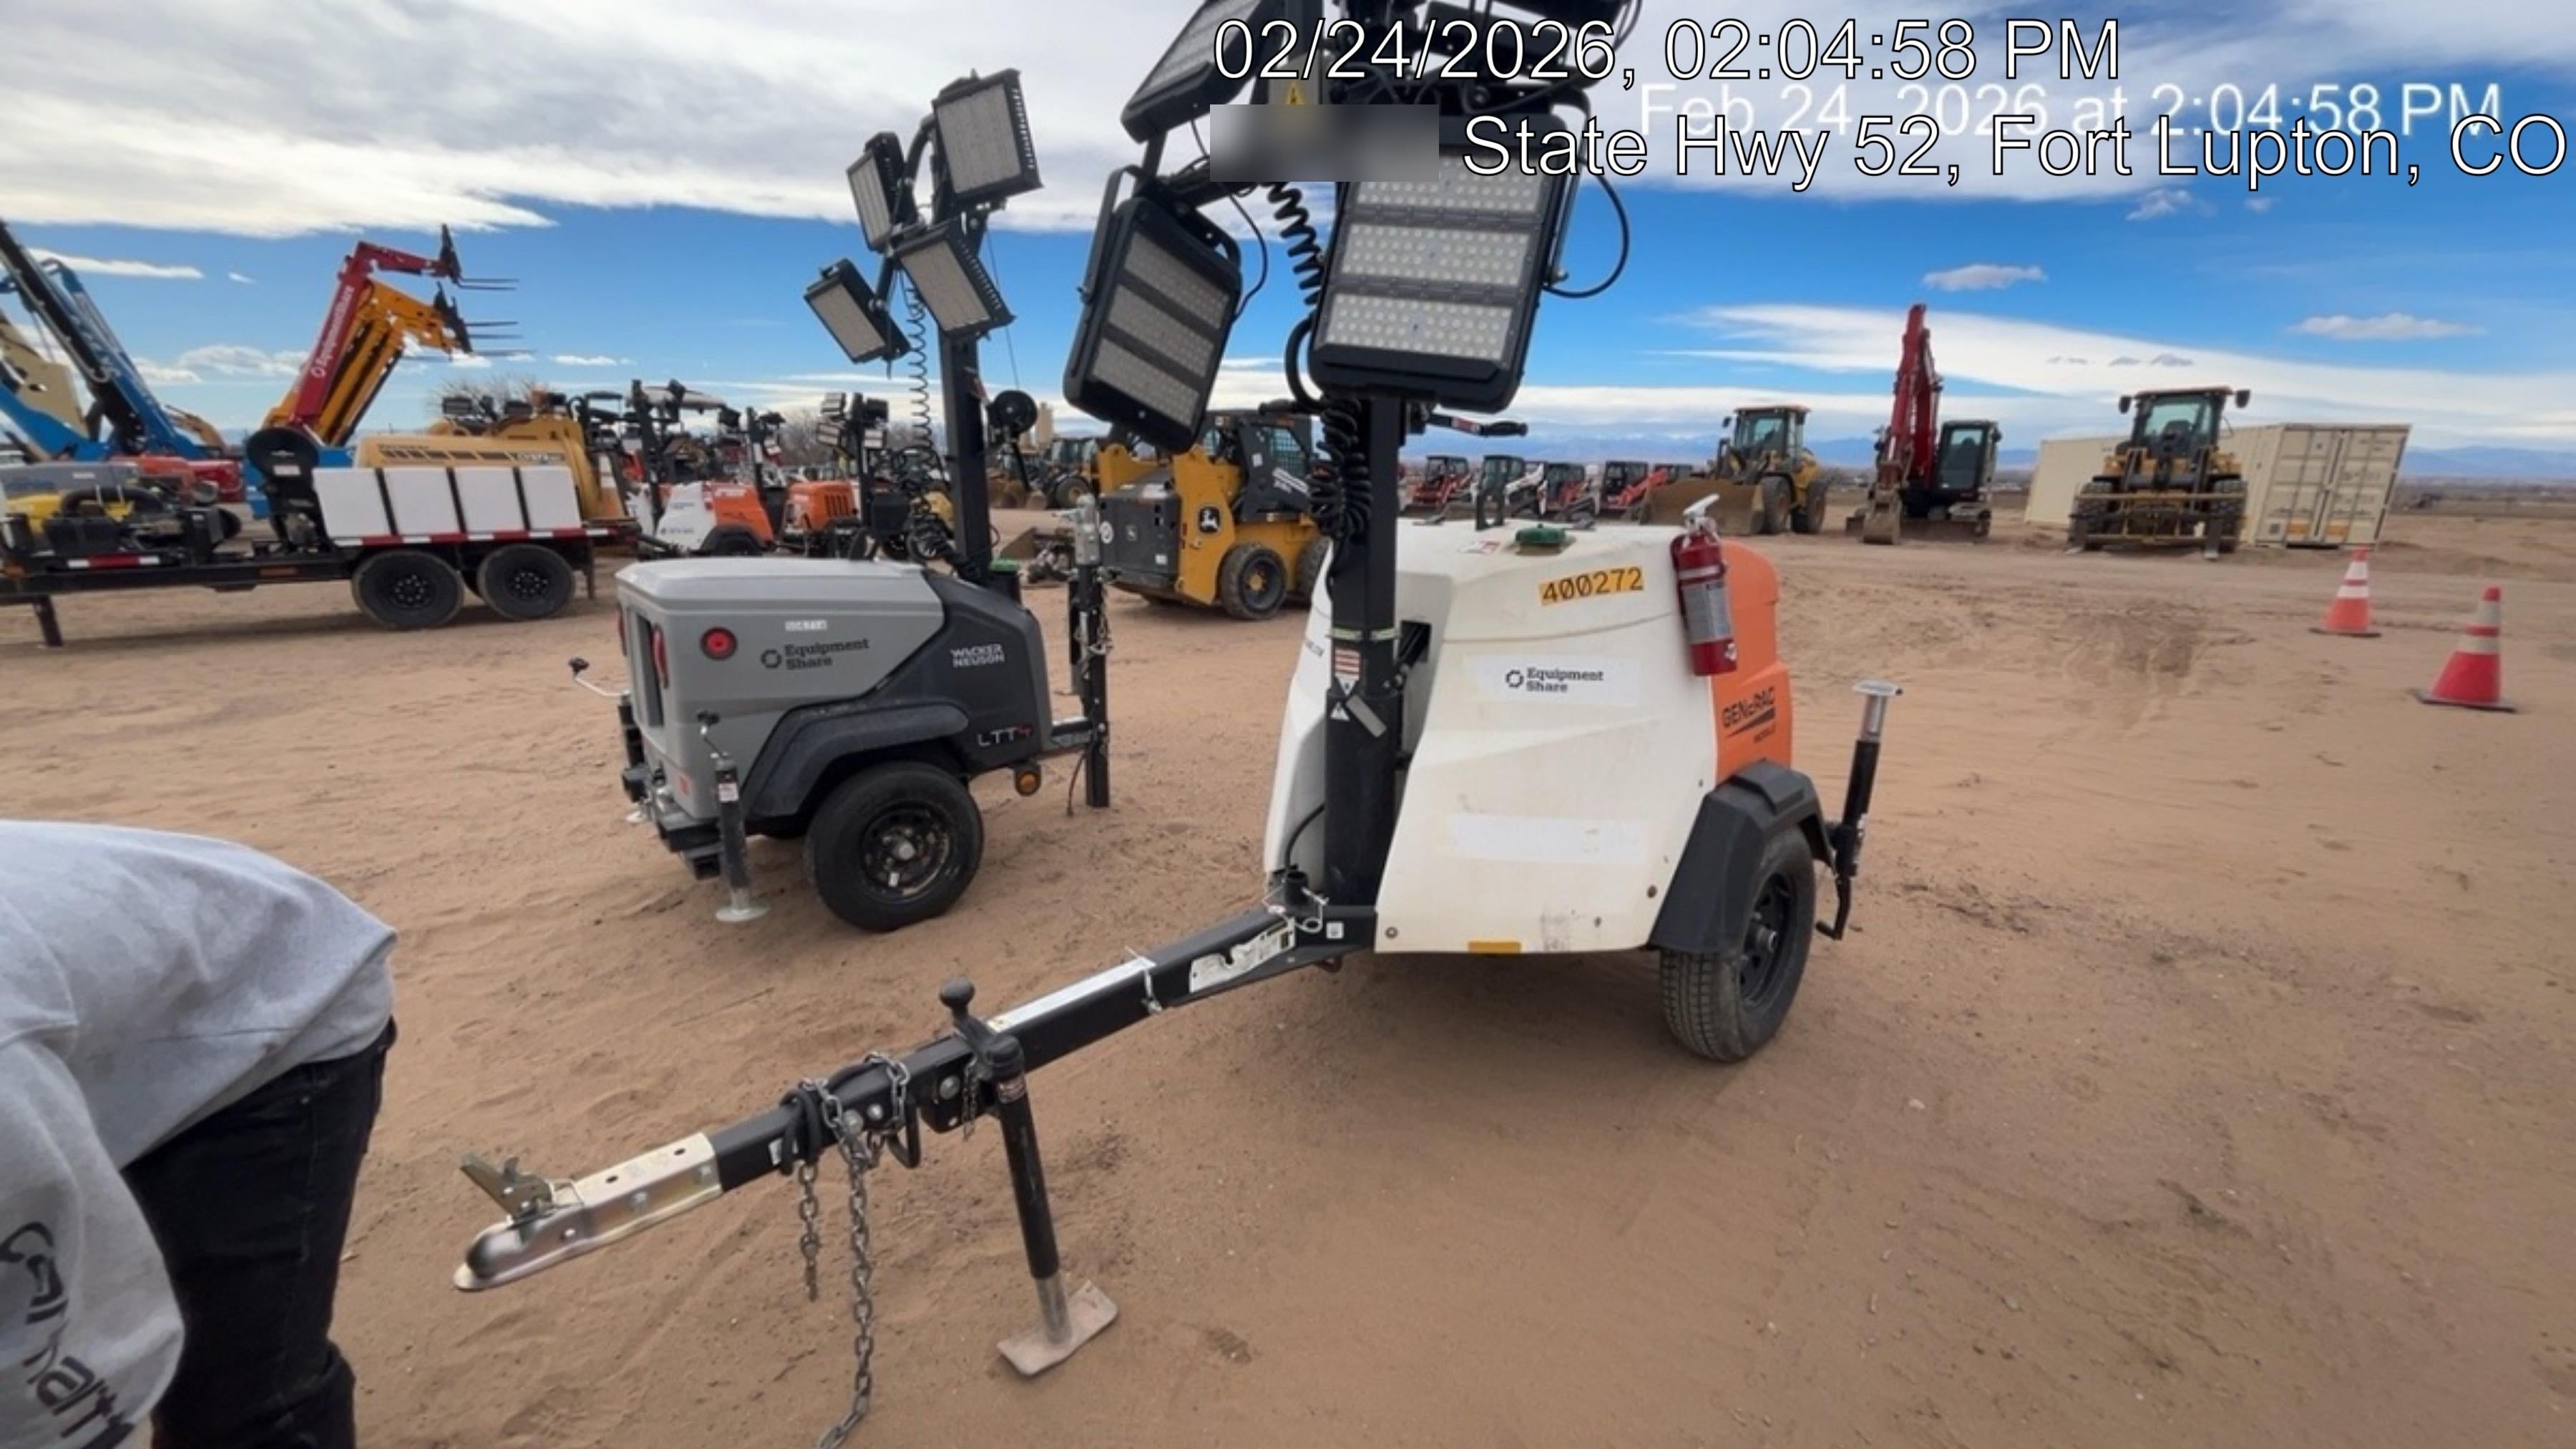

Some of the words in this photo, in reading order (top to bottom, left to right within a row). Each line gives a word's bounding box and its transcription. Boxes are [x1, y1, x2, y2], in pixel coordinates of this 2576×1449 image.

[1543, 567, 1644, 602] 400272
[784, 638, 870, 657] Equipment
[950, 643, 1003, 657] WACKER
[786, 657, 833, 670] Share
[952, 654, 1005, 668] NEUSON
[1526, 667, 1604, 682] Equipment
[1526, 680, 1568, 693] Share
